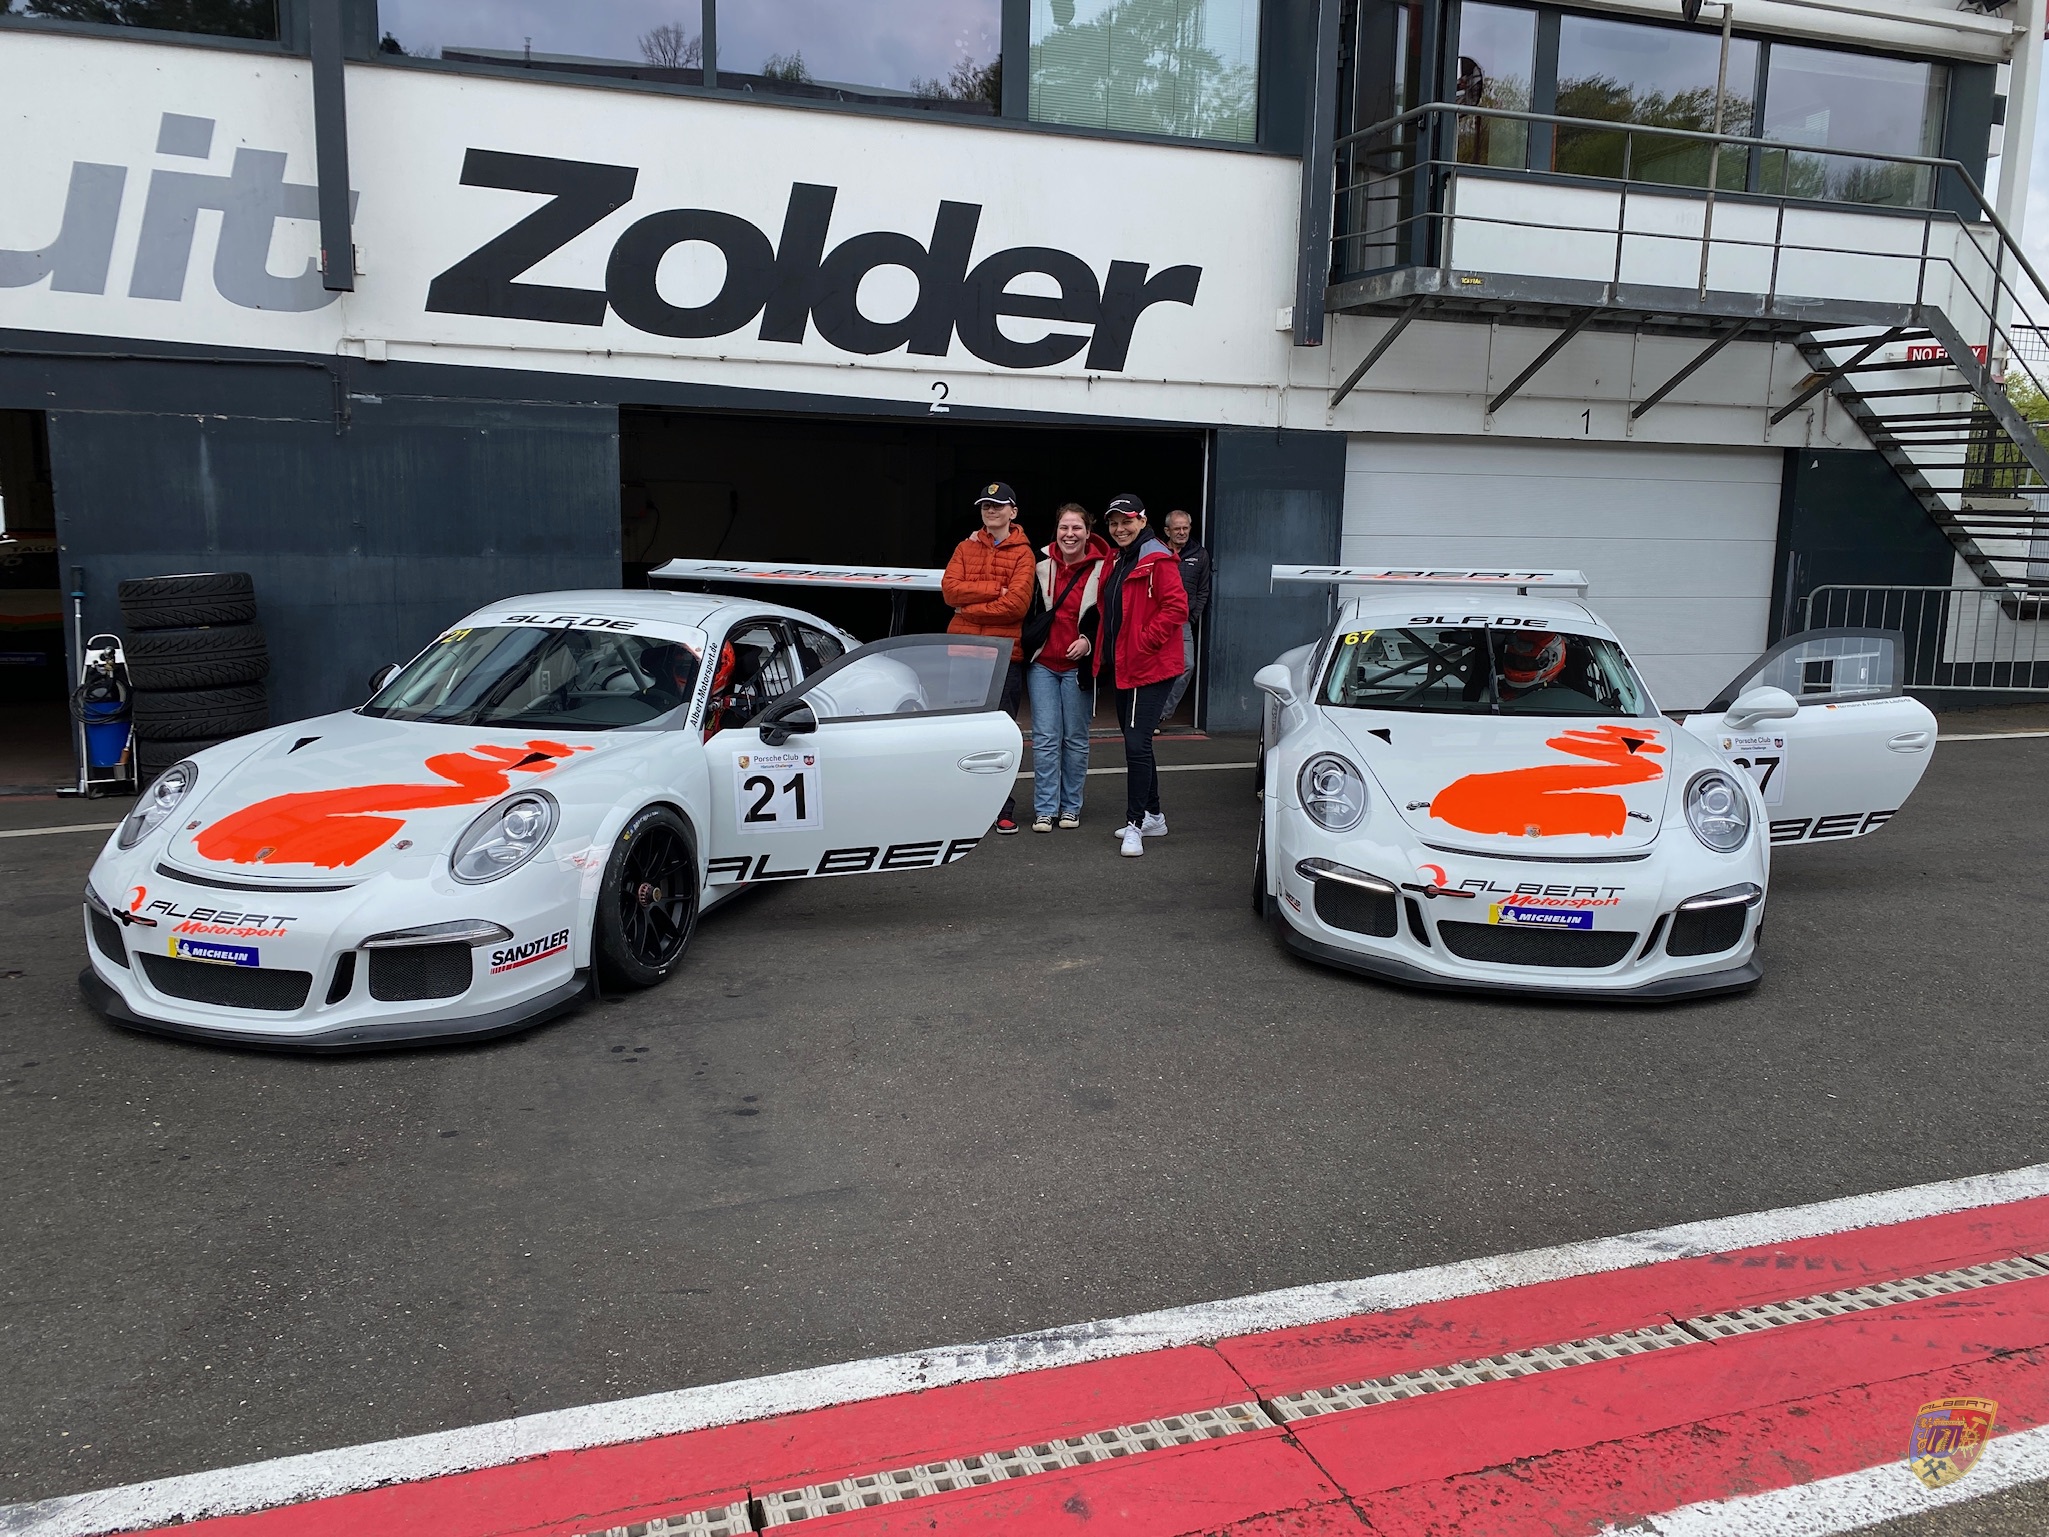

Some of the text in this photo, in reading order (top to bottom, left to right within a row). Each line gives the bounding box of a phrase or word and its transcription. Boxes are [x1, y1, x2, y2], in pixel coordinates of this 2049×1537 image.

[425, 148, 1202, 371] Zolder
[1912, 348, 1932, 361] NO
[930, 381, 950, 413] 2
[1581, 408, 1590, 434] 1
[694, 566, 928, 580] ALBERT
[1299, 569, 1554, 579] ALBERT
[1408, 616, 1549, 628] 9LF.DE
[441, 628, 474, 644] 21
[1344, 629, 1376, 645] 67
[690, 643, 718, 728] Albert-Motorsport.de
[744, 773, 806, 823] 21
[1459, 879, 1626, 899] ALBERT
[1497, 893, 1621, 908] Motorsport
[145, 900, 298, 928] ALBERT
[1518, 912, 1583, 924] MICHELIN
[172, 920, 288, 938] Motorsport
[192, 948, 249, 961] MICHELIN
[491, 928, 570, 967] SANDTLER
